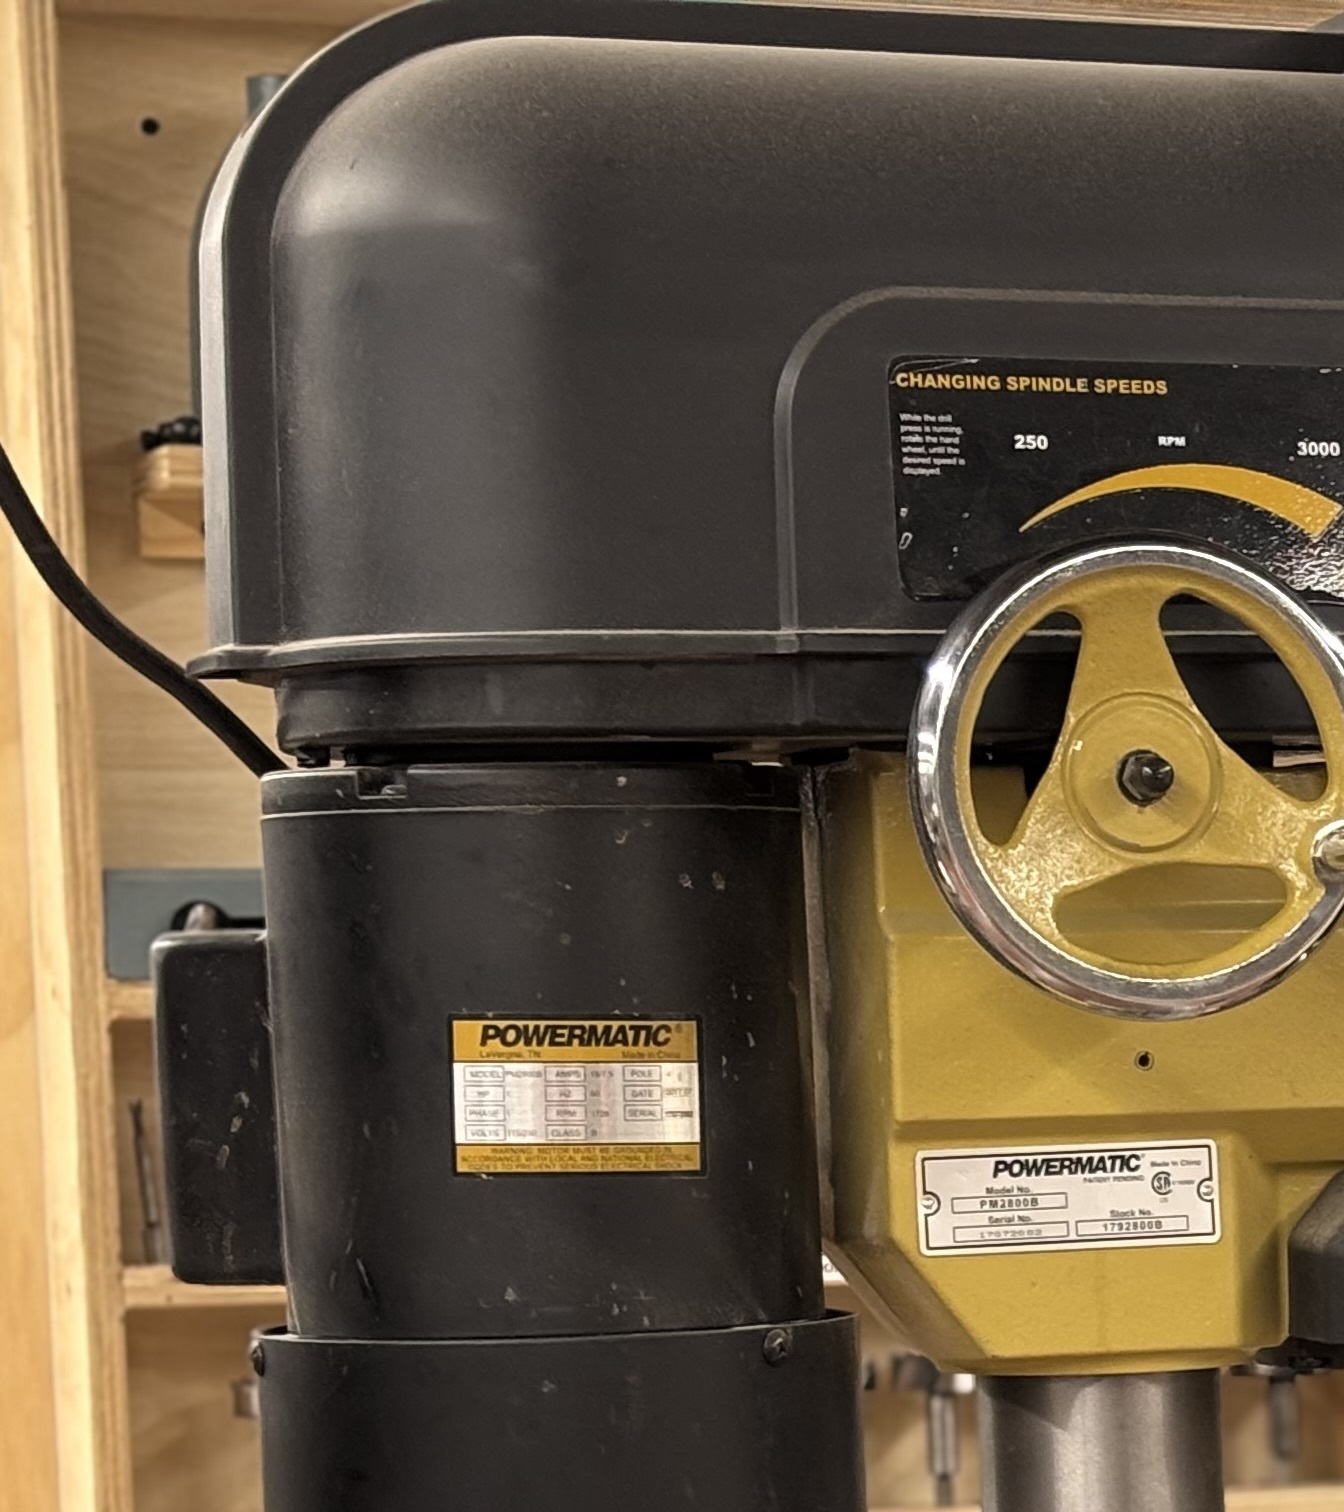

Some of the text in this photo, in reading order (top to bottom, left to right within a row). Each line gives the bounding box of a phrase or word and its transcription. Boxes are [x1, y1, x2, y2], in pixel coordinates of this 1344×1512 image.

[896, 373, 1168, 395] CHANGING SPINDLE SPEEDS
[1013, 434, 1049, 450] 250
[1157, 436, 1186, 447] RPM
[1297, 441, 1341, 457] 3000
[480, 1024, 672, 1048] POWERMATIC
[992, 1153, 1142, 1179] POWERMATIC
[985, 1186, 1014, 1195] Model
